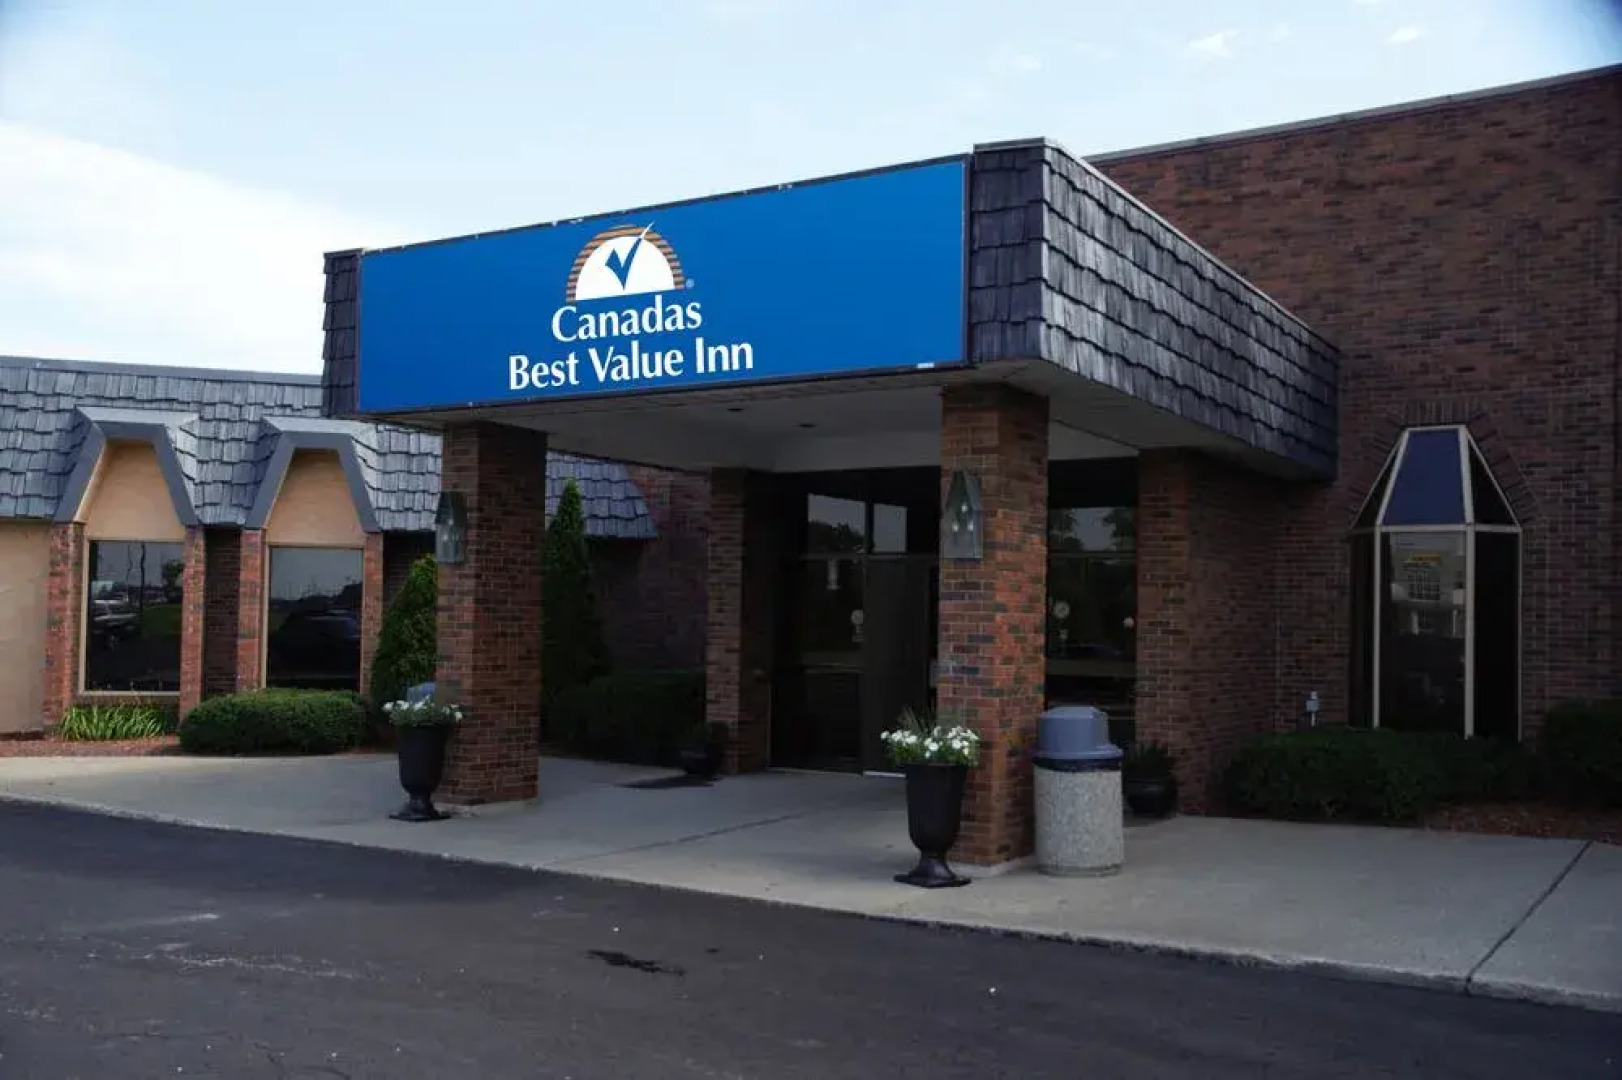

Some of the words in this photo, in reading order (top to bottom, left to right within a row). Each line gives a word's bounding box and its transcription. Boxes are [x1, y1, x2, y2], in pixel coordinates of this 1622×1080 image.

[552, 295, 702, 342] Canadas
[509, 352, 579, 390] Best
[589, 341, 684, 382] Value
[696, 337, 754, 374] Inn
